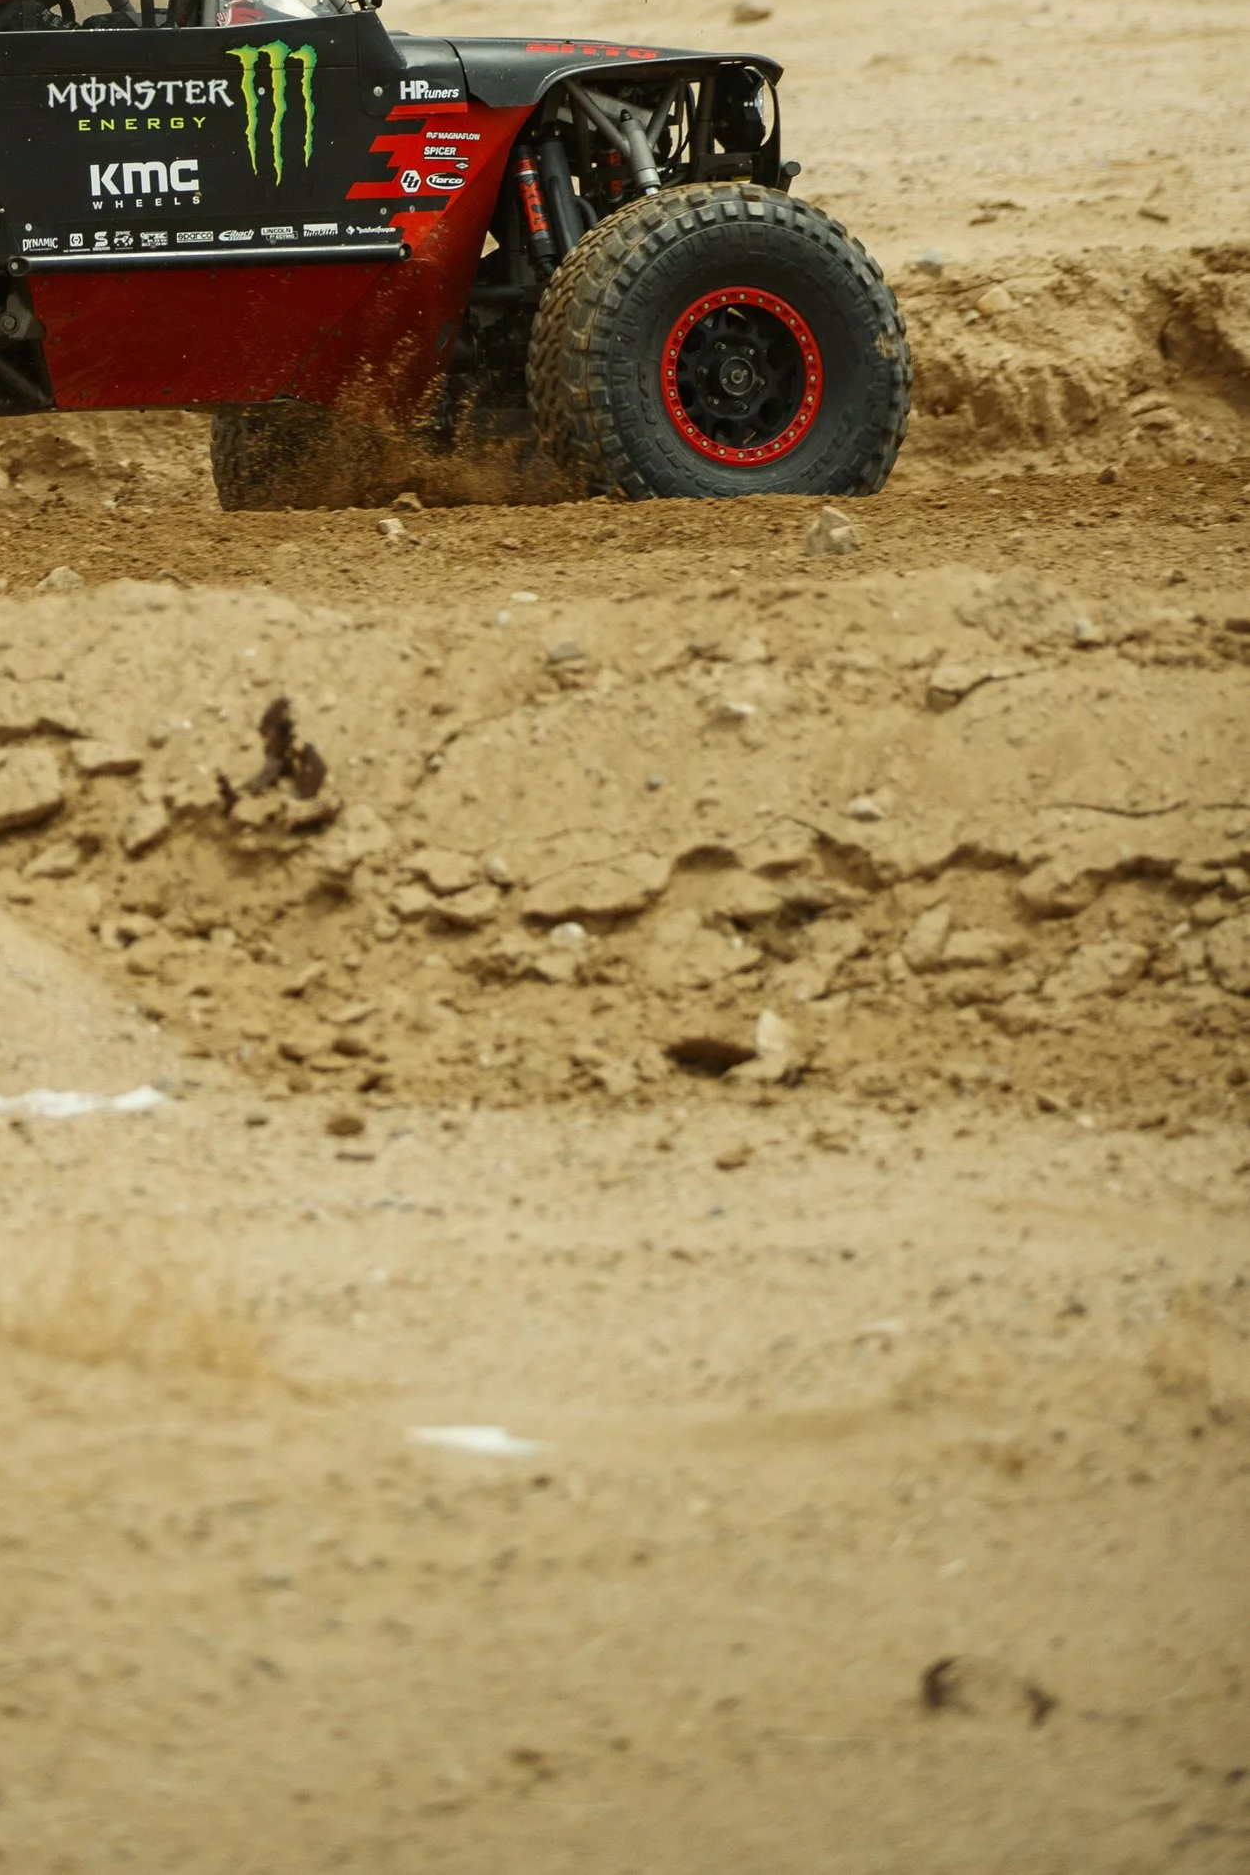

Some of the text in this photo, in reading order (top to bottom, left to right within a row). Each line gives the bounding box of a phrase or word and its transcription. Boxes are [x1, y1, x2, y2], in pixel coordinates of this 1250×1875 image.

[47, 76, 235, 113] MONSTER
[78, 117, 206, 131] ENERGY
[423, 146, 457, 156] SPICER
[89, 159, 200, 196] KMC
[430, 174, 464, 184] Torco
[92, 197, 200, 210] WHEELS
[177, 233, 213, 241] sparco
[22, 237, 59, 252] DYNAMIC
